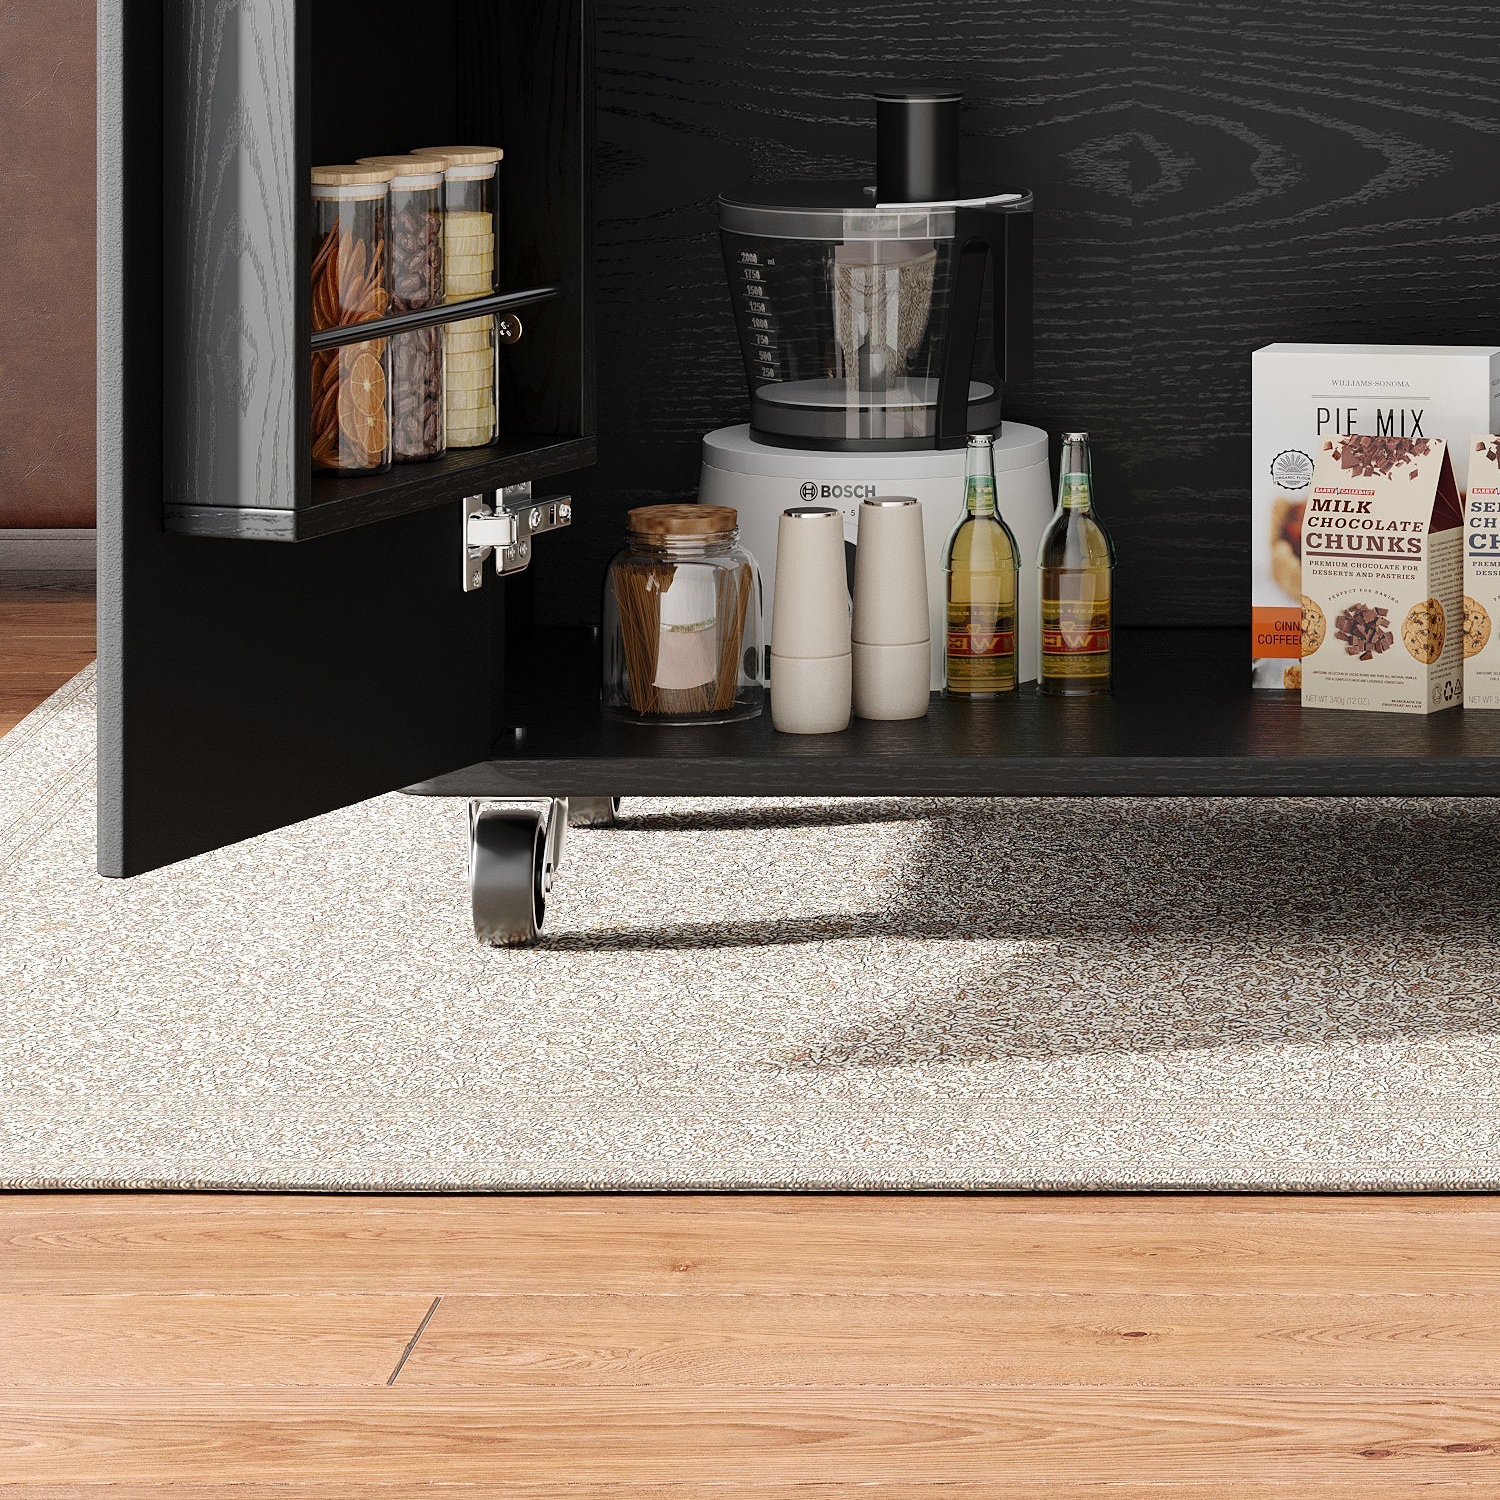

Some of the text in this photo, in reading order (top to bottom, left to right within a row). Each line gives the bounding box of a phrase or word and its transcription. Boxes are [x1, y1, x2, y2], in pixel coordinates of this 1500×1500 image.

[744, 268, 760, 280] 1750
[749, 300, 766, 313] 1250
[759, 350, 772, 362] 500
[761, 367, 775, 378] 250
[1317, 407, 1424, 437] PIE MIX
[821, 484, 876, 498] BOSCH
[1311, 499, 1373, 514] MILK
[1307, 517, 1424, 532] CHOCOLATE
[1306, 532, 1422, 553] CHUNKS
[1309, 560, 1348, 568] PREMIUM
[1350, 562, 1400, 570] CHOCOLATE
[1312, 569, 1353, 577] DESSERTS
[1328, 588, 1356, 601] PERFECT
[1375, 589, 1400, 604] BAKING
[1274, 620, 1302, 631] CINN
[1319, 695, 1329, 703] WT
[1330, 696, 1345, 706] 340g
[1468, 696, 1482, 704] NET
[1482, 696, 1493, 704] WT
